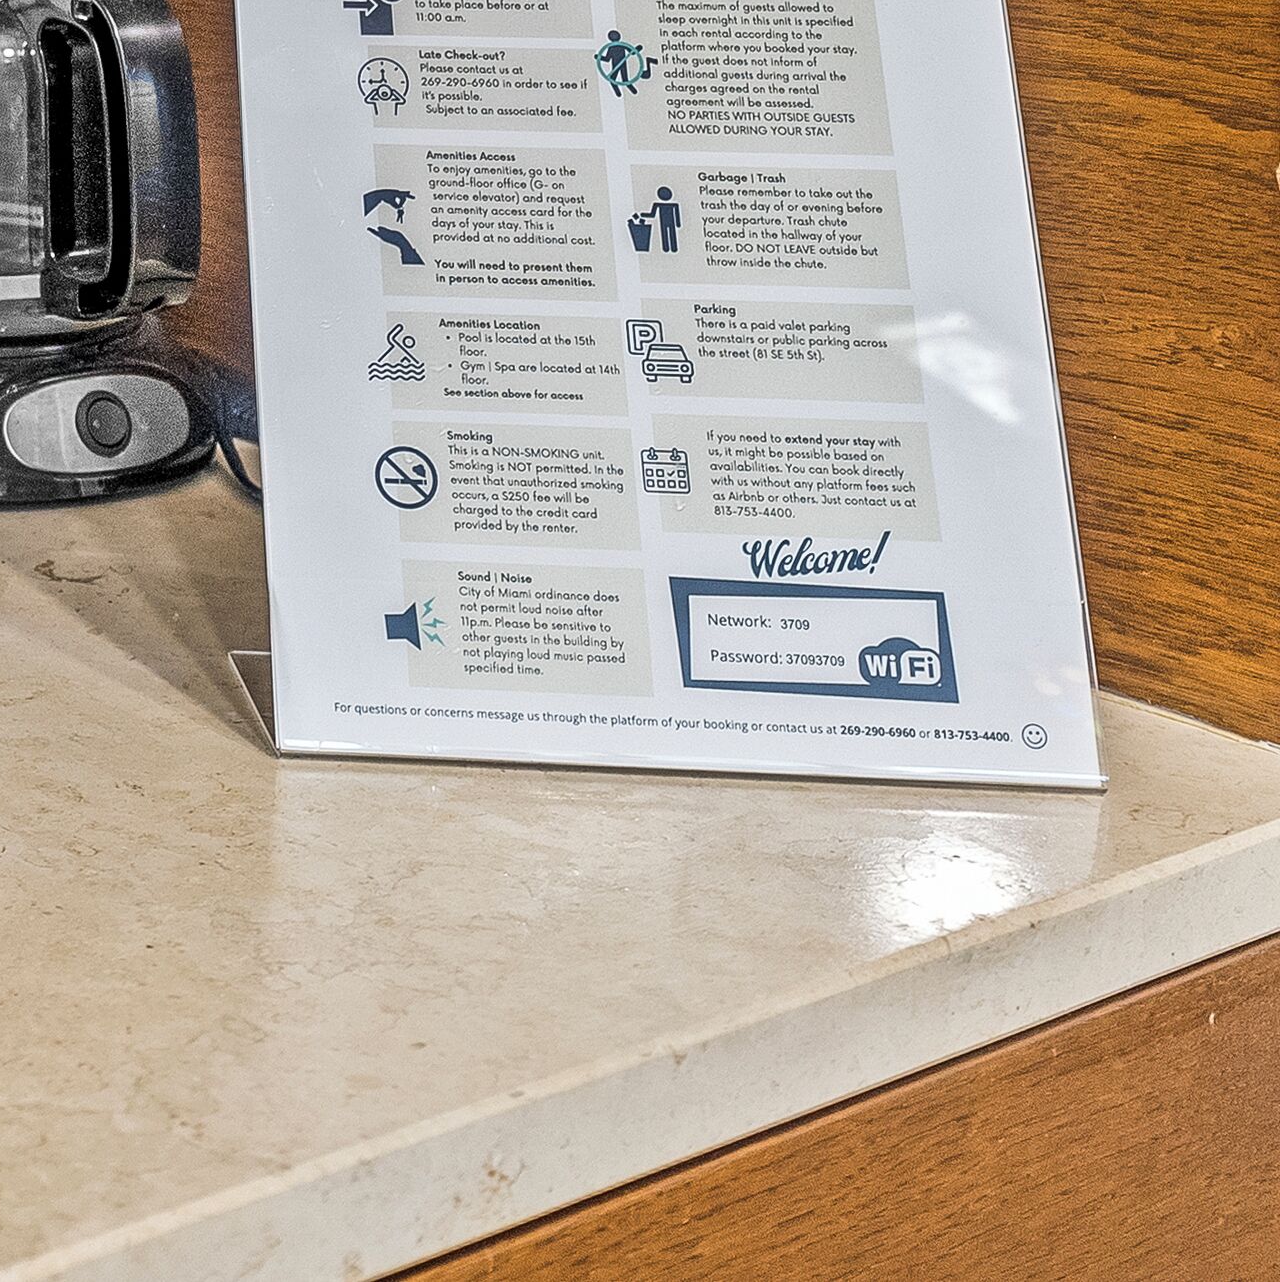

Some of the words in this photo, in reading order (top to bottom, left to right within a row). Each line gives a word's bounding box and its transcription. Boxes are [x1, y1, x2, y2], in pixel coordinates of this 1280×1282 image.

[655, 0, 675, 11] The
[678, 2, 727, 11] maximum
[729, 0, 740, 12] of
[742, 3, 776, 15] guests
[777, 1, 820, 13] allowed
[822, 4, 834, 13] to
[416, 12, 442, 22] 11:00
[444, 15, 466, 23] a.m.
[418, 49, 442, 60] Late
[444, 49, 506, 61] Check-out?
[421, 76, 500, 88] 269-290-6960
[502, 79, 512, 88] in
[514, 78, 544, 89] order
[545, 80, 557, 89] to
[559, 82, 578, 90] see
[580, 78, 588, 90] if
[667, 110, 686, 120] NO
[688, 110, 731, 121] PARTIES
[731, 111, 761, 121] WITH
[763, 111, 810, 123] OUTSIDE
[813, 112, 856, 124] GUESTS
[668, 124, 721, 135] ALLOWED
[723, 125, 768, 136] DURING
[770, 126, 803, 136] YOUR
[804, 126, 833, 137] STAY.
[425, 150, 478, 161] Amenities
[479, 151, 516, 162] Access
[426, 163, 440, 174] To
[442, 165, 471, 177] enjoy
[473, 166, 527, 177] amenities,
[528, 168, 543, 180] go
[545, 167, 557, 176] to
[559, 165, 576, 177] the
[697, 171, 748, 186] Garbage
[756, 172, 786, 184] Trash
[705, 240, 733, 253] floor.
[735, 243, 754, 253] DO
[756, 243, 781, 254] NOT
[783, 244, 816, 255] LEAVE
[818, 244, 858, 256] outside
[860, 244, 879, 257] but
[693, 303, 736, 318] Parking
[438, 318, 491, 329] Amenities
[493, 319, 541, 331] Location
[698, 345, 716, 358] the
[719, 348, 750, 359] street
[752, 347, 768, 362] (81
[770, 349, 784, 360] SE
[787, 348, 805, 360] 5th
[806, 349, 825, 363] St).
[443, 387, 462, 397] See
[464, 389, 499, 398] section
[501, 388, 532, 399] above
[534, 388, 548, 400] for
[550, 393, 584, 401] access
[446, 429, 493, 445] Smoking
[706, 429, 714, 441] If
[716, 434, 736, 445] you
[739, 431, 767, 443] need
[770, 433, 782, 444] to
[784, 433, 823, 445] extend
[825, 437, 850, 448] your
[852, 437, 876, 449] stay
[877, 435, 901, 447] with
[447, 443, 468, 456] This
[470, 446, 479, 456] is
[481, 448, 490, 456] a
[492, 446, 580, 459] NON-SMOKING
[582, 450, 605, 460] unit.
[714, 505, 795, 519] 813-753-4400.
[742, 530, 891, 578] Welcome!
[457, 570, 491, 582] Sound
[500, 572, 532, 584] Noise
[458, 586, 481, 600] City
[483, 585, 495, 597] of
[498, 588, 532, 599] Miami
[534, 588, 590, 601] ordinance
[593, 590, 620, 603] does
[707, 613, 772, 628] Network:
[780, 618, 810, 631] 3709
[710, 649, 783, 665] Password:
[785, 653, 845, 667] 37093709
[334, 702, 352, 713] For
[354, 704, 408, 716] questions
[409, 707, 422, 716] or
[424, 708, 474, 719] concerns
[476, 710, 524, 723] message
[527, 713, 540, 721] us
[542, 711, 587, 726] through
[589, 713, 608, 725] the
[610, 714, 659, 727] platform
[661, 716, 673, 728] of
[674, 719, 700, 731] your
[703, 718, 749, 734] booking
[751, 723, 763, 732] or
[766, 723, 807, 734] contact
[810, 725, 824, 734] us
[826, 725, 838, 735] at
[840, 724, 916, 738] 269-290-6960
[918, 730, 931, 739] or
[934, 729, 1013, 743] 813-753-4400.
